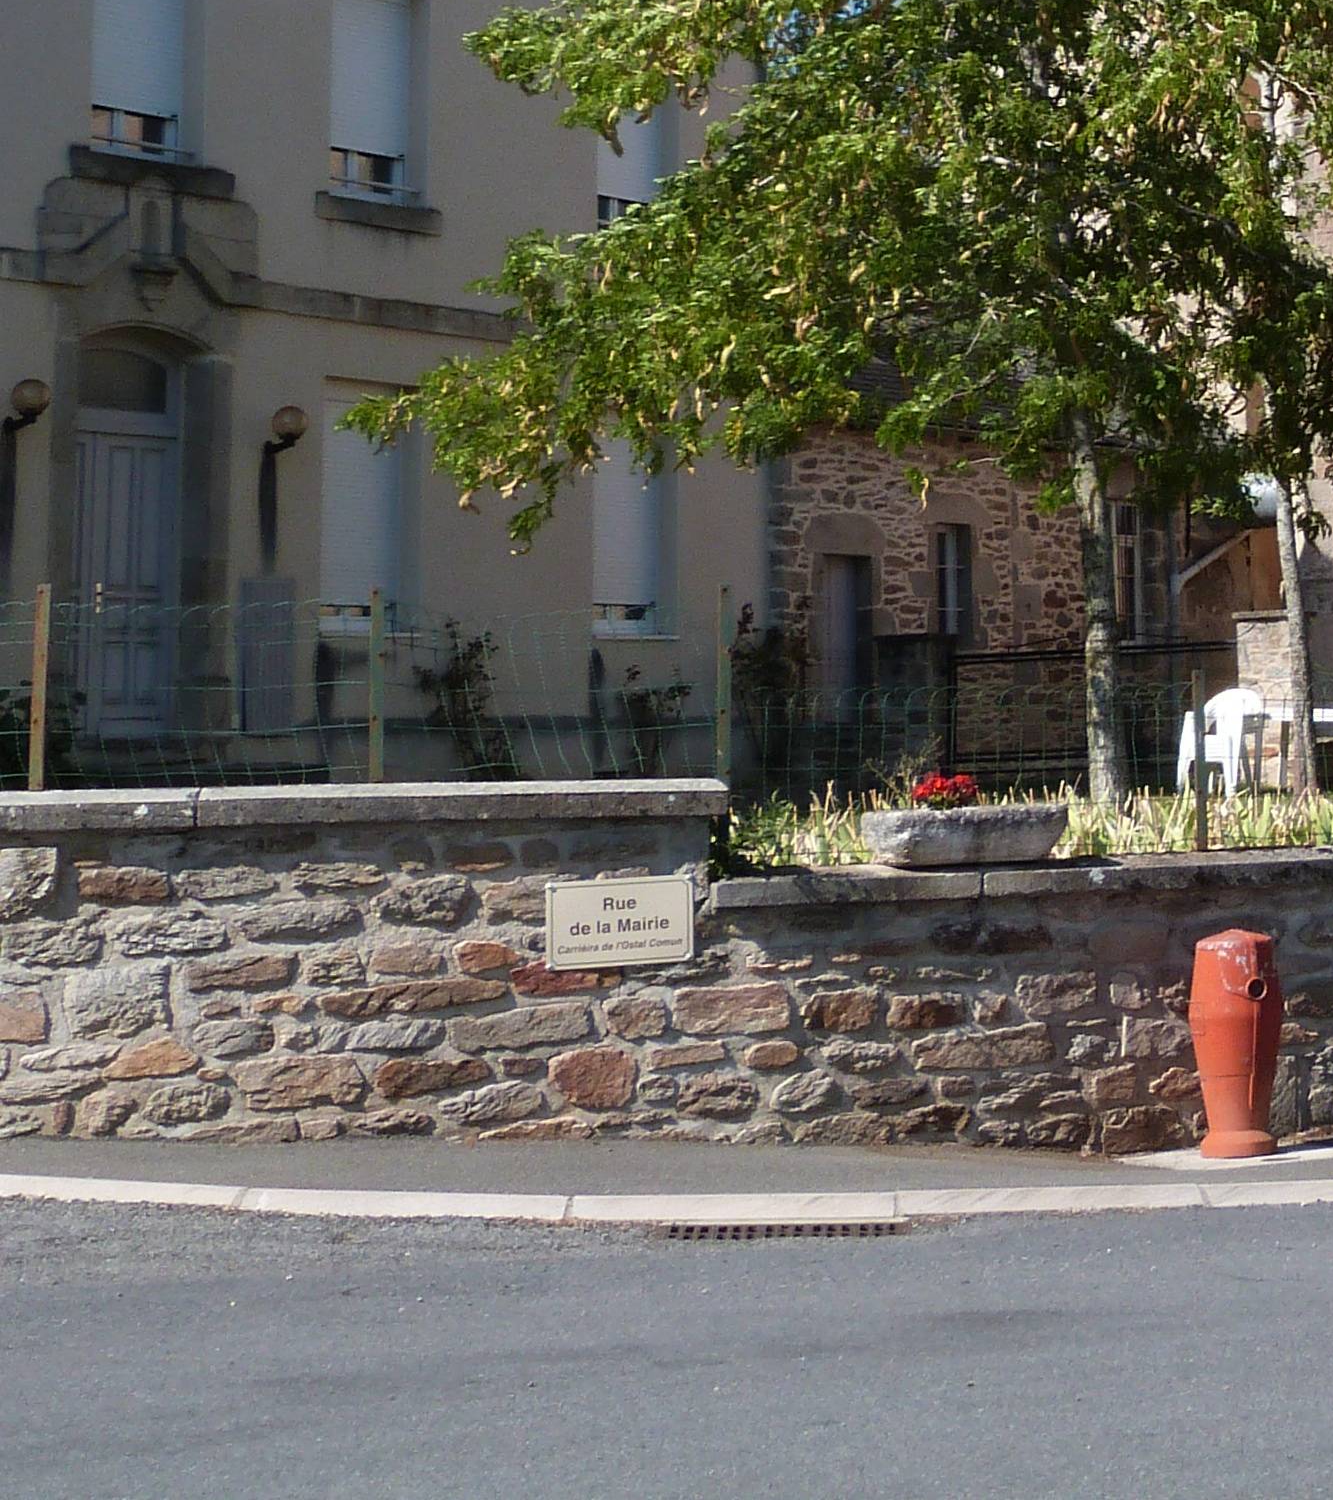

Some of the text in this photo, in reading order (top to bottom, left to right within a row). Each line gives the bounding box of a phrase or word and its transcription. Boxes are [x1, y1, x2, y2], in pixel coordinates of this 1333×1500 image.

[603, 897, 637, 911] Rue
[569, 916, 670, 936] de la Mairie
[602, 942, 613, 951] de
